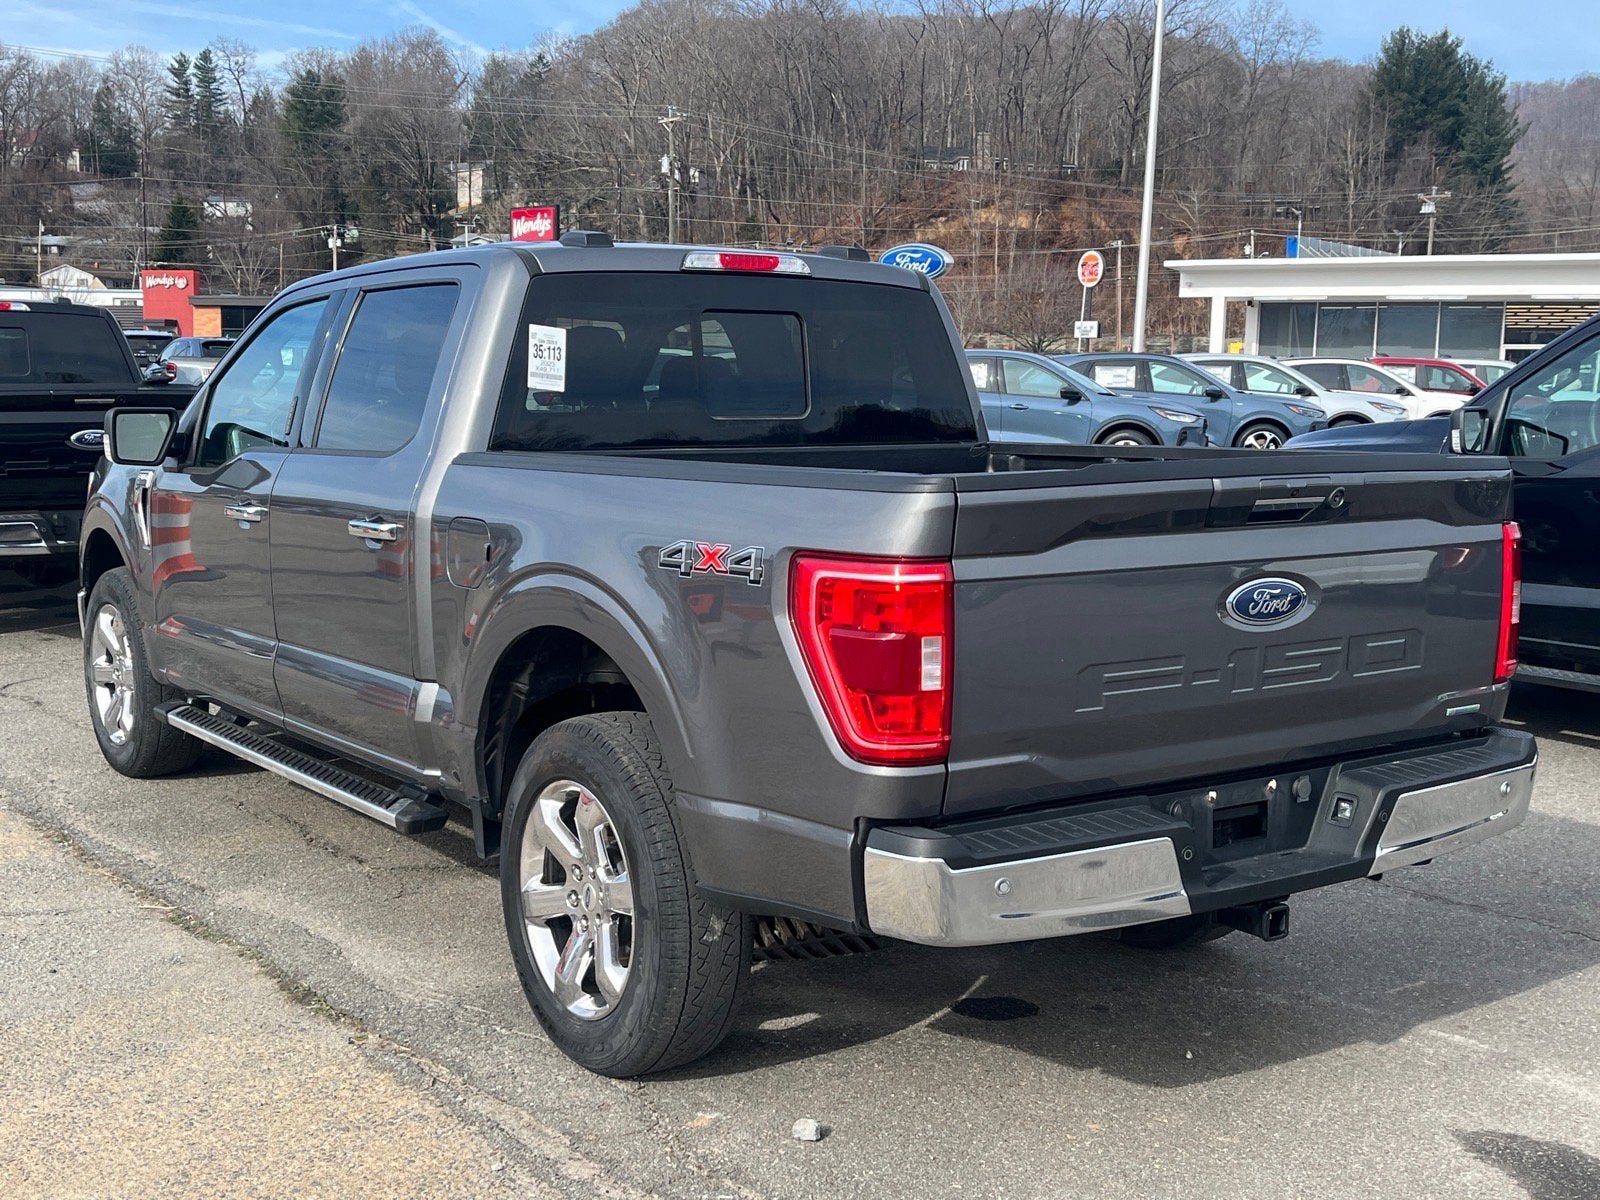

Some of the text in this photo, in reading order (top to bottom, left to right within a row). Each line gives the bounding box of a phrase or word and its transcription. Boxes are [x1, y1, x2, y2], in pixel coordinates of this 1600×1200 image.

[513, 212, 551, 238] Wendy's
[893, 252, 931, 273] Ford
[146, 273, 174, 288] Wendy's
[533, 343, 562, 361] 35:113
[1249, 588, 1293, 615] Ford
[1075, 628, 1425, 712] F-150
